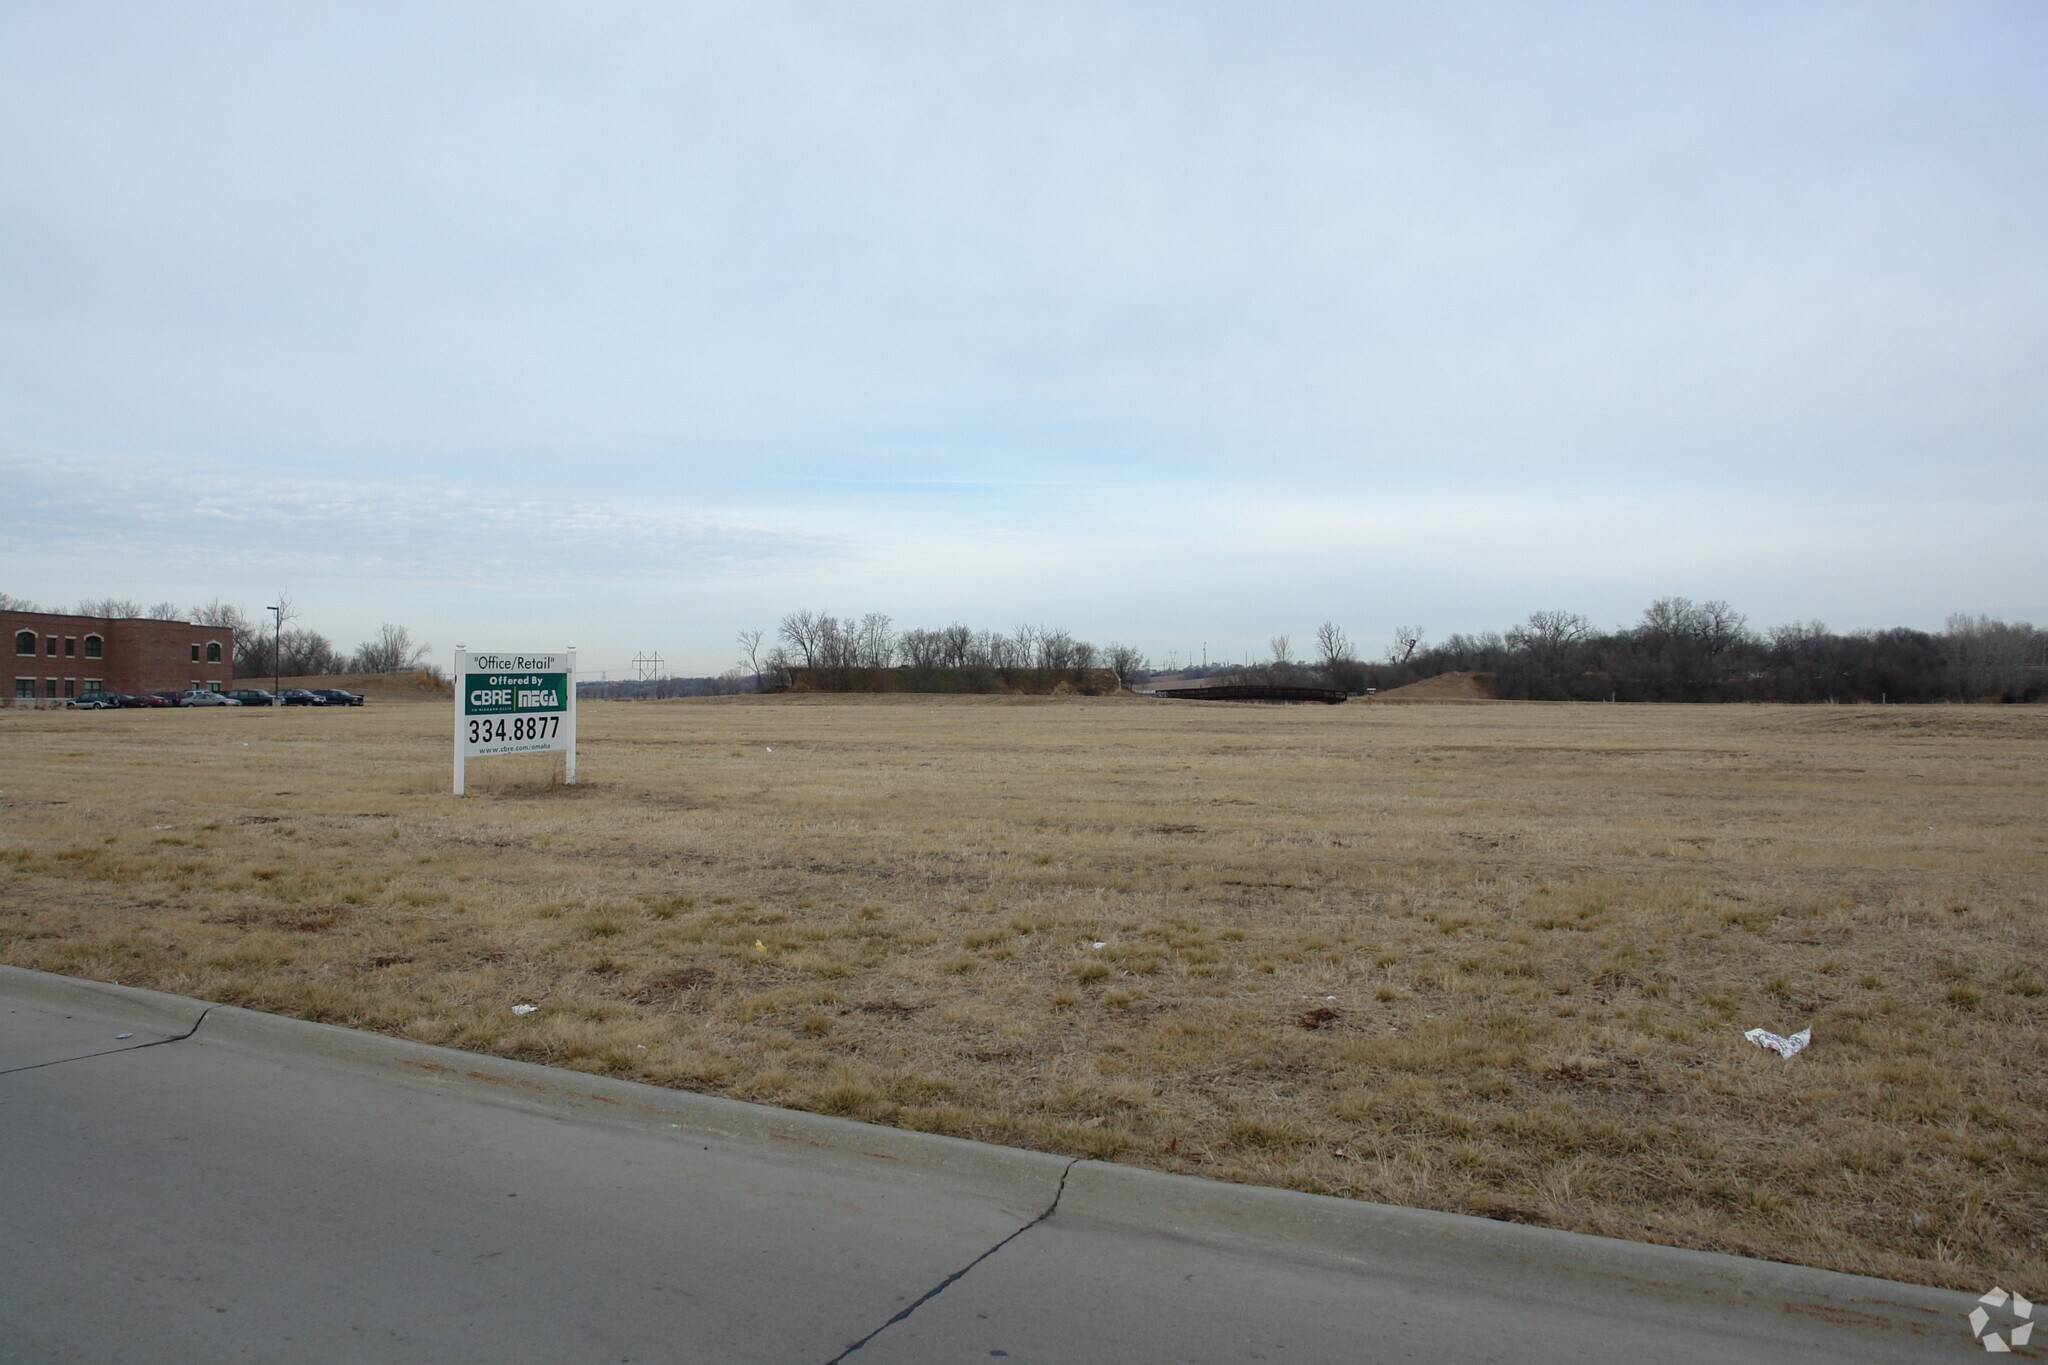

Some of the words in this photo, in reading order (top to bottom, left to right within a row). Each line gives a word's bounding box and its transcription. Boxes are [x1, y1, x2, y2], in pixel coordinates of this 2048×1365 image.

[474, 655, 555, 670] "Office/Retail"
[489, 676, 530, 686] Offered
[531, 676, 543, 686] By
[470, 689, 512, 706] CBRE
[469, 716, 559, 744] 334.8877
[479, 743, 551, 754] www.cbre.com/omaha
